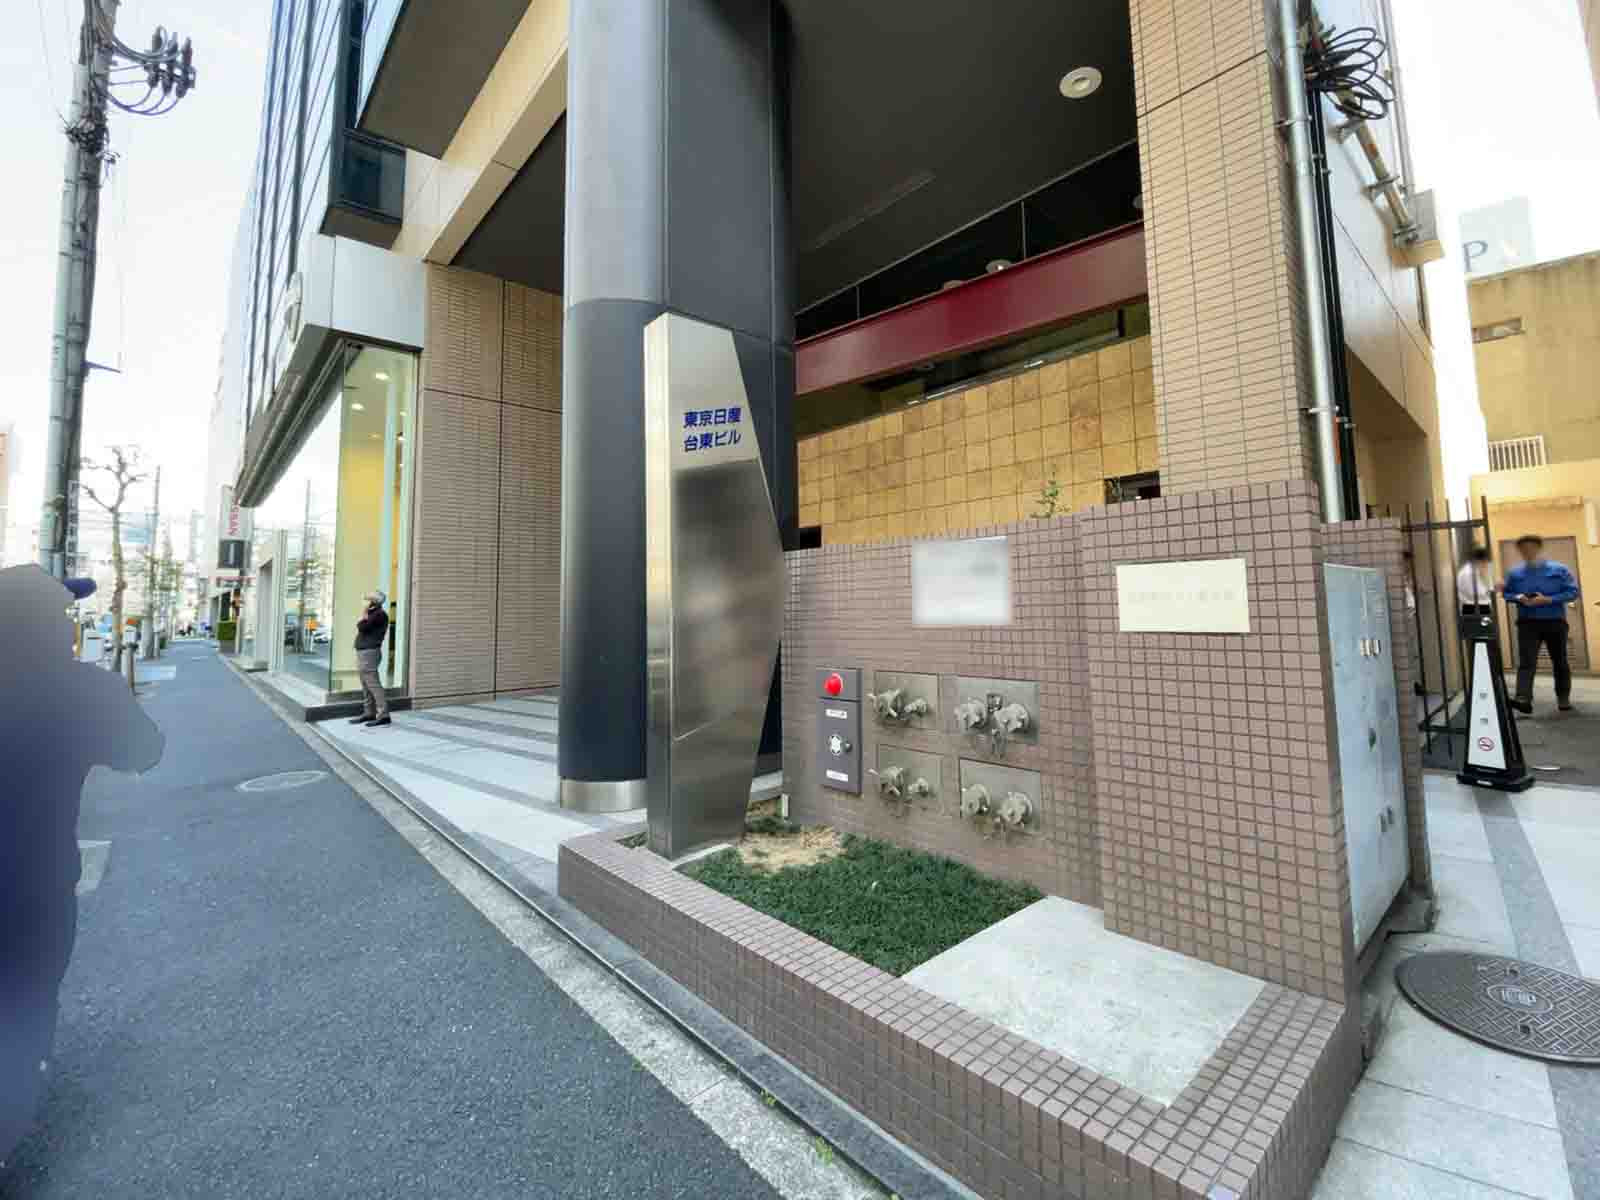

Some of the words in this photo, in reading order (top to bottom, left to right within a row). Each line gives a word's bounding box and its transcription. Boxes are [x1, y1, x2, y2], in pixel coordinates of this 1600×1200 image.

[683, 408, 741, 428] 東京日産
[683, 429, 741, 452] 台東ビル
